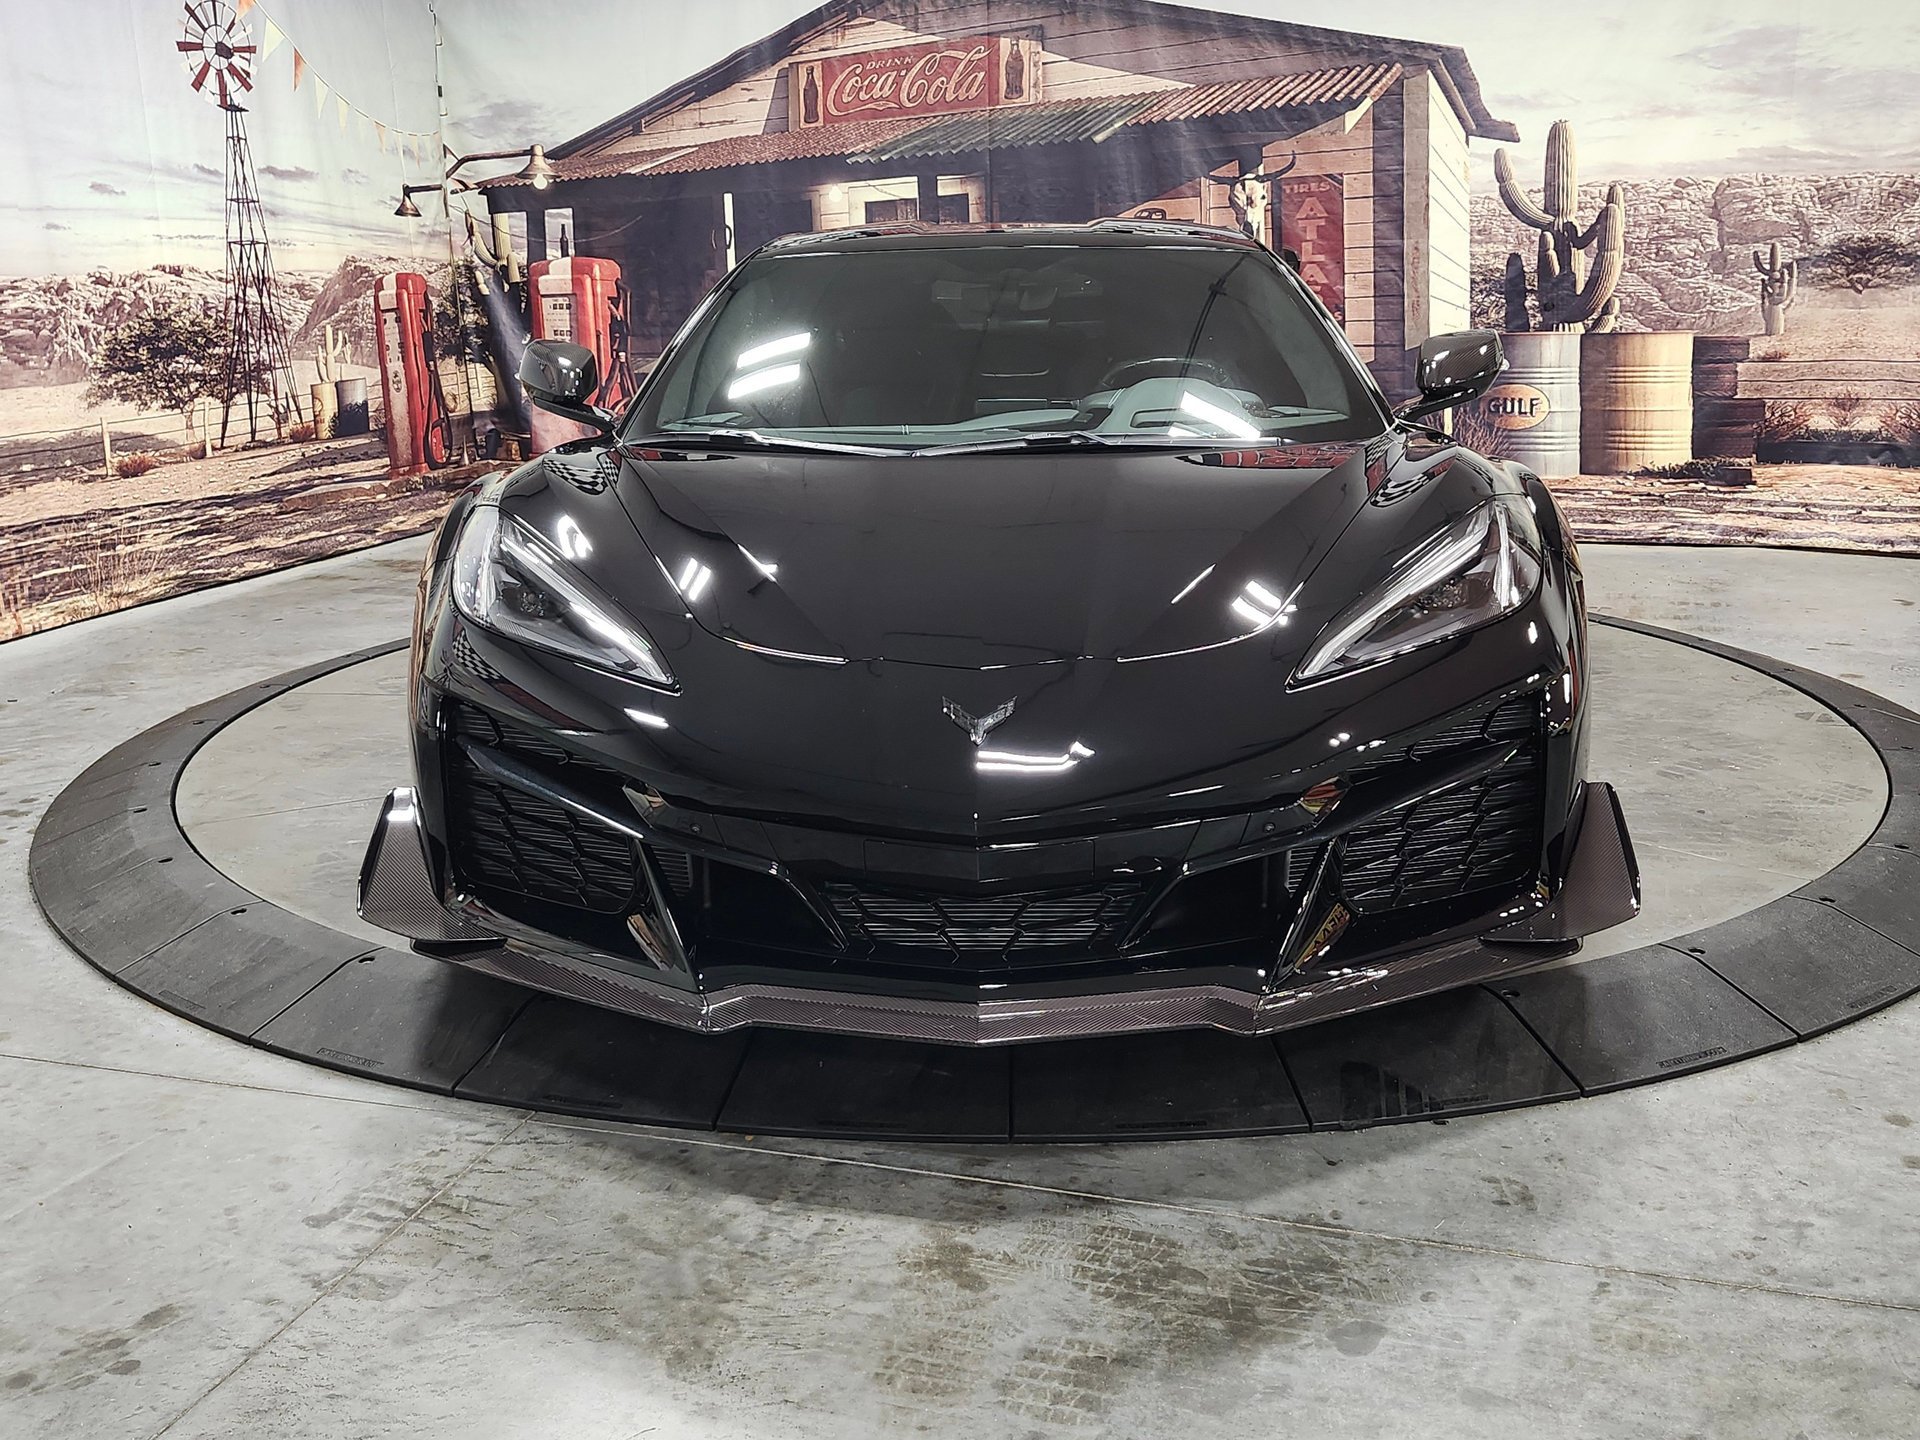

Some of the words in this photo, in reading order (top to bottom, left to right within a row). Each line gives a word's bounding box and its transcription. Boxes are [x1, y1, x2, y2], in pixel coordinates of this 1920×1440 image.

[866, 55, 914, 70] DRINK
[826, 45, 993, 117] Coca-Cola
[1282, 181, 1331, 194] TIRES
[1488, 397, 1542, 417] GULF
